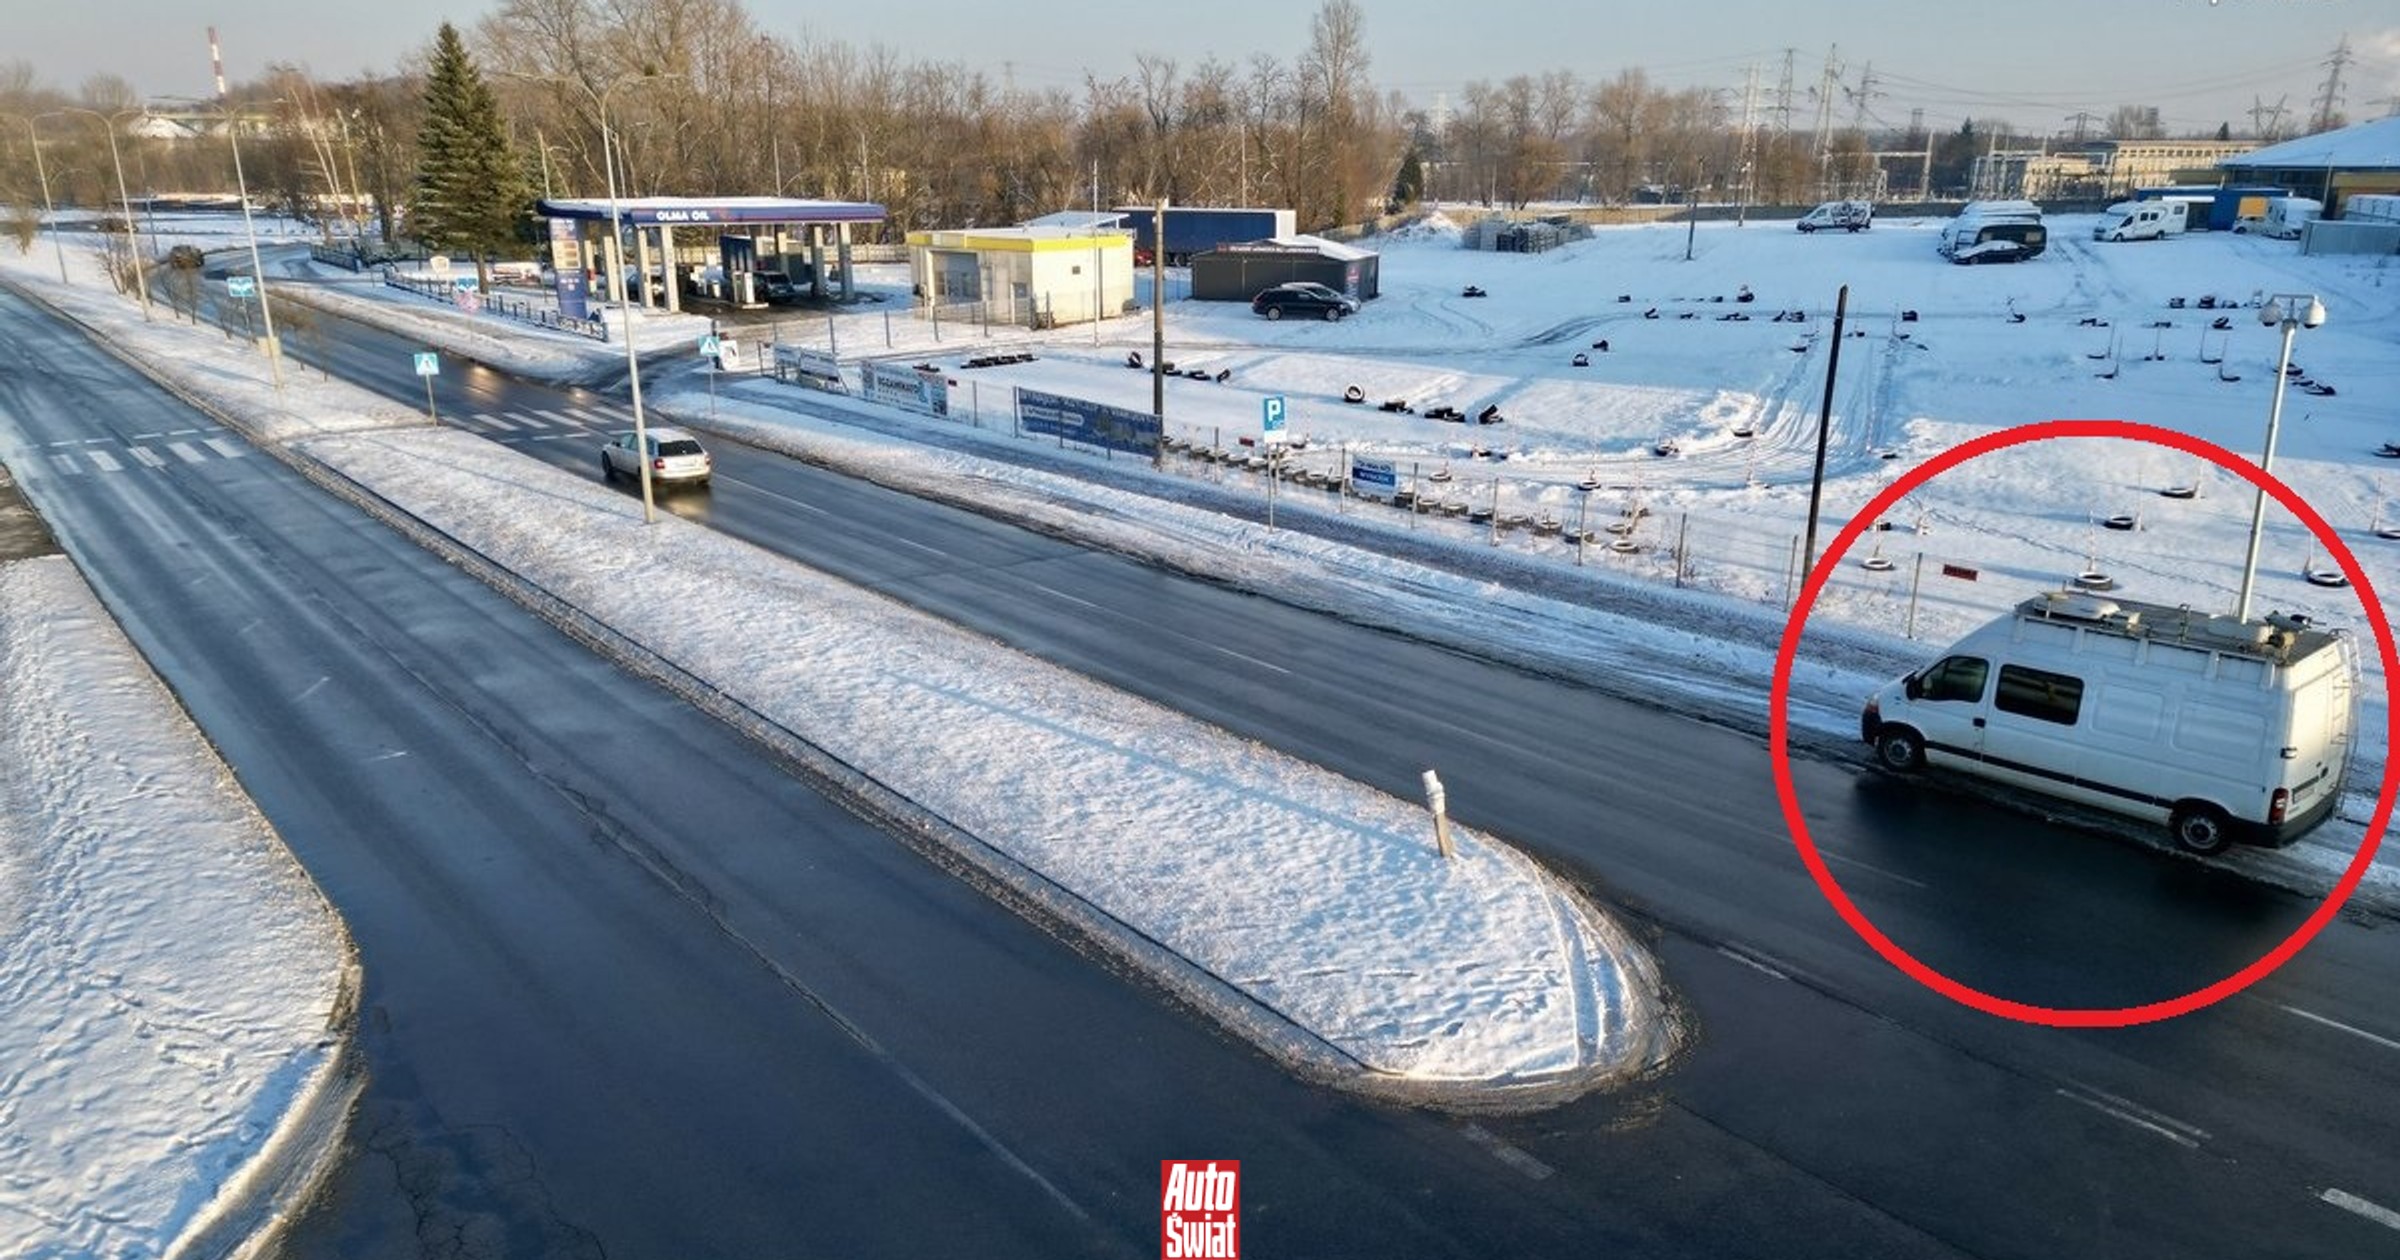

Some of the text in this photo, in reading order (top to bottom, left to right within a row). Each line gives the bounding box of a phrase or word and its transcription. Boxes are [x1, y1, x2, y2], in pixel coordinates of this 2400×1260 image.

[656, 210, 709, 221] OLMA OIL
[1268, 400, 1281, 421] P
